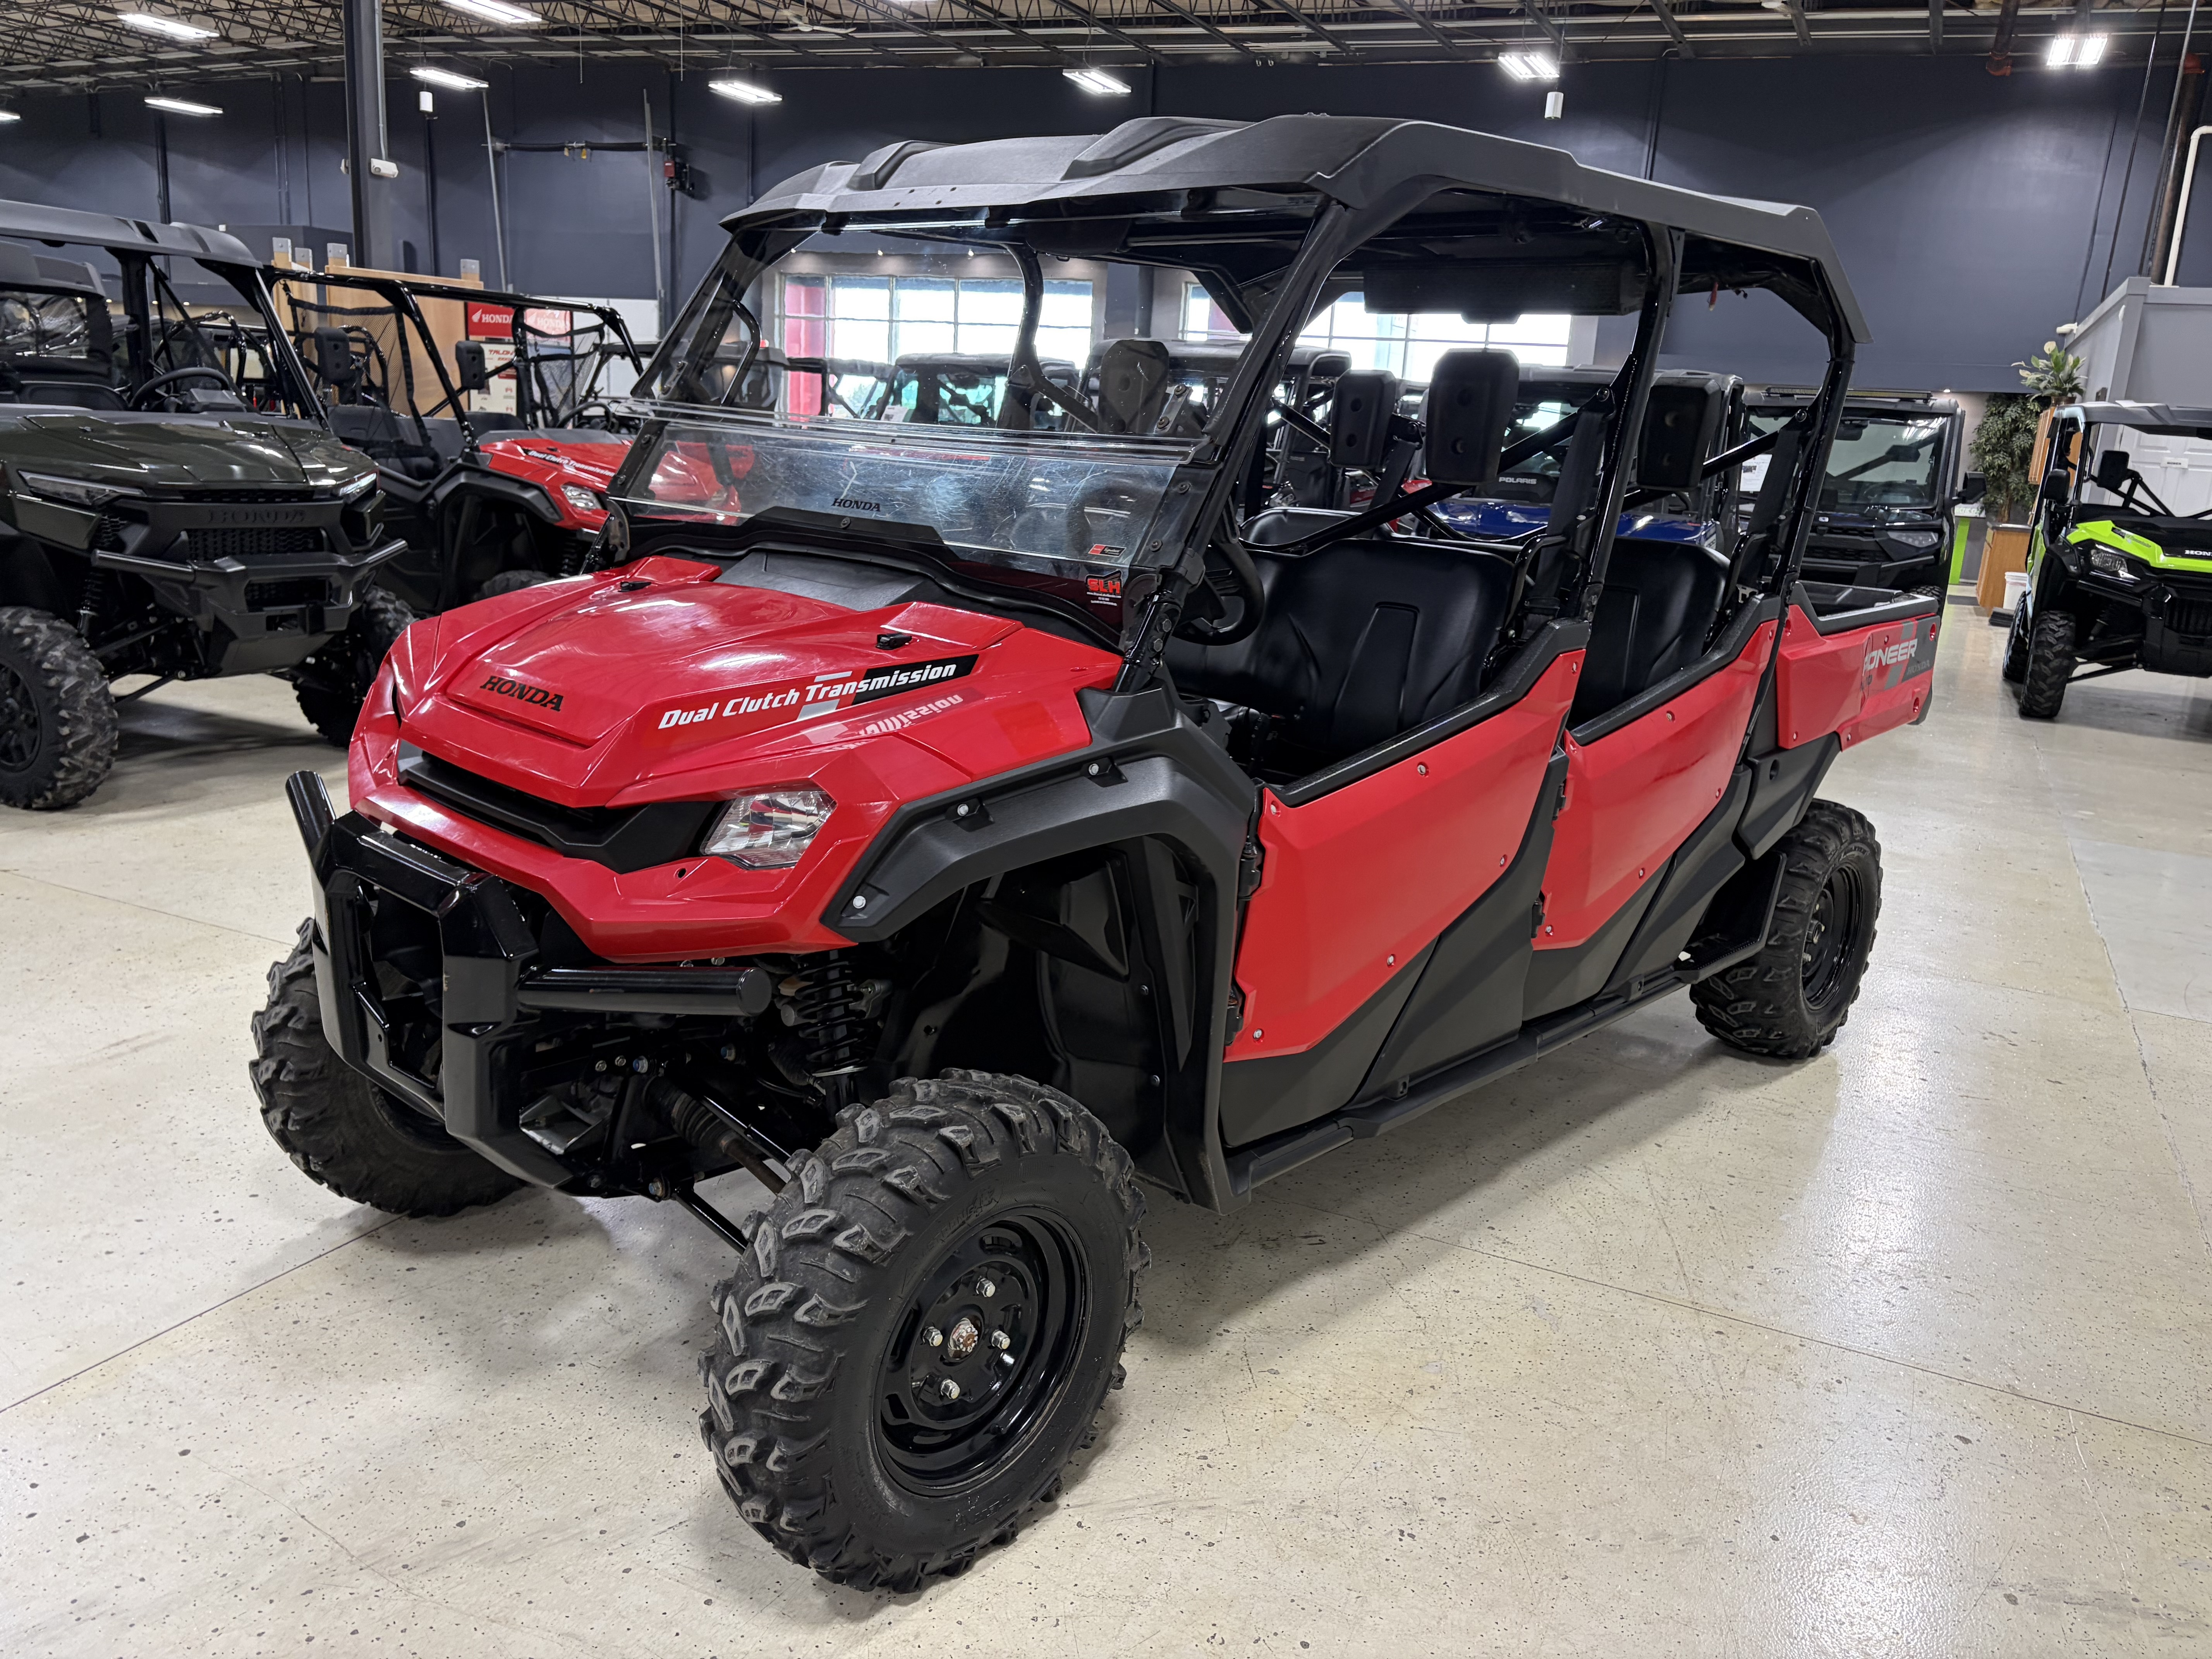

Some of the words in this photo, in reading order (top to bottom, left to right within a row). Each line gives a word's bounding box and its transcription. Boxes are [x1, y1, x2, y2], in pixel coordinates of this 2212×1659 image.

[831, 498, 881, 512] HONDA
[207, 508, 306, 523] HONDA
[1087, 578, 1121, 594] SLH
[1907, 659, 1930, 675] HONDA
[479, 675, 564, 712] HONDA
[658, 702, 719, 730] Dual
[722, 688, 799, 717] Clutch
[805, 664, 957, 702] Transmission
